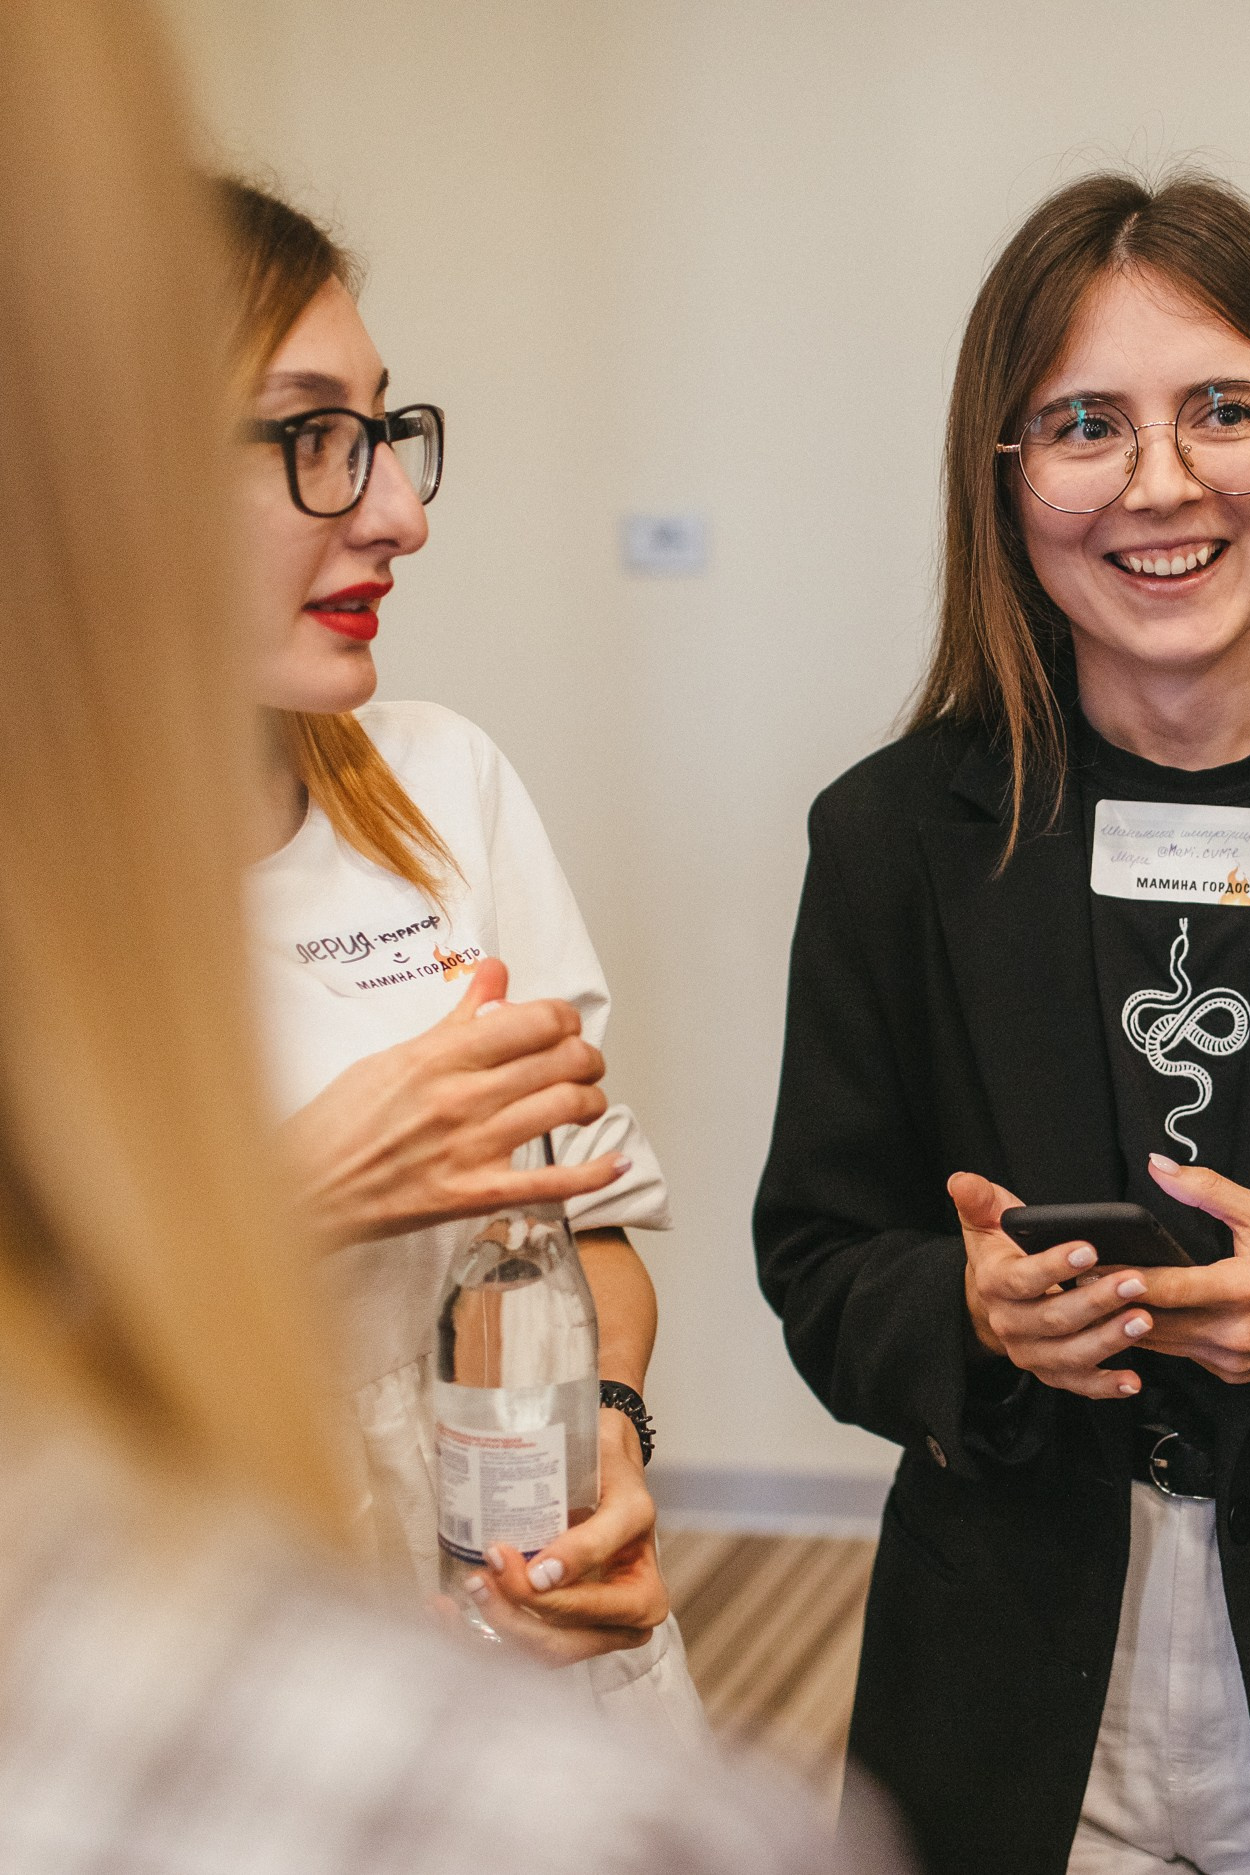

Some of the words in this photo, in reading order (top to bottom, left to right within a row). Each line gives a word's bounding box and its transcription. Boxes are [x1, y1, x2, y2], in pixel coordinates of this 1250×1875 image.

[1136, 877, 1197, 891] МАМИНА
[356, 970, 416, 990] МАМИНА
[417, 946, 481, 978] ГОРДОСТЬ
